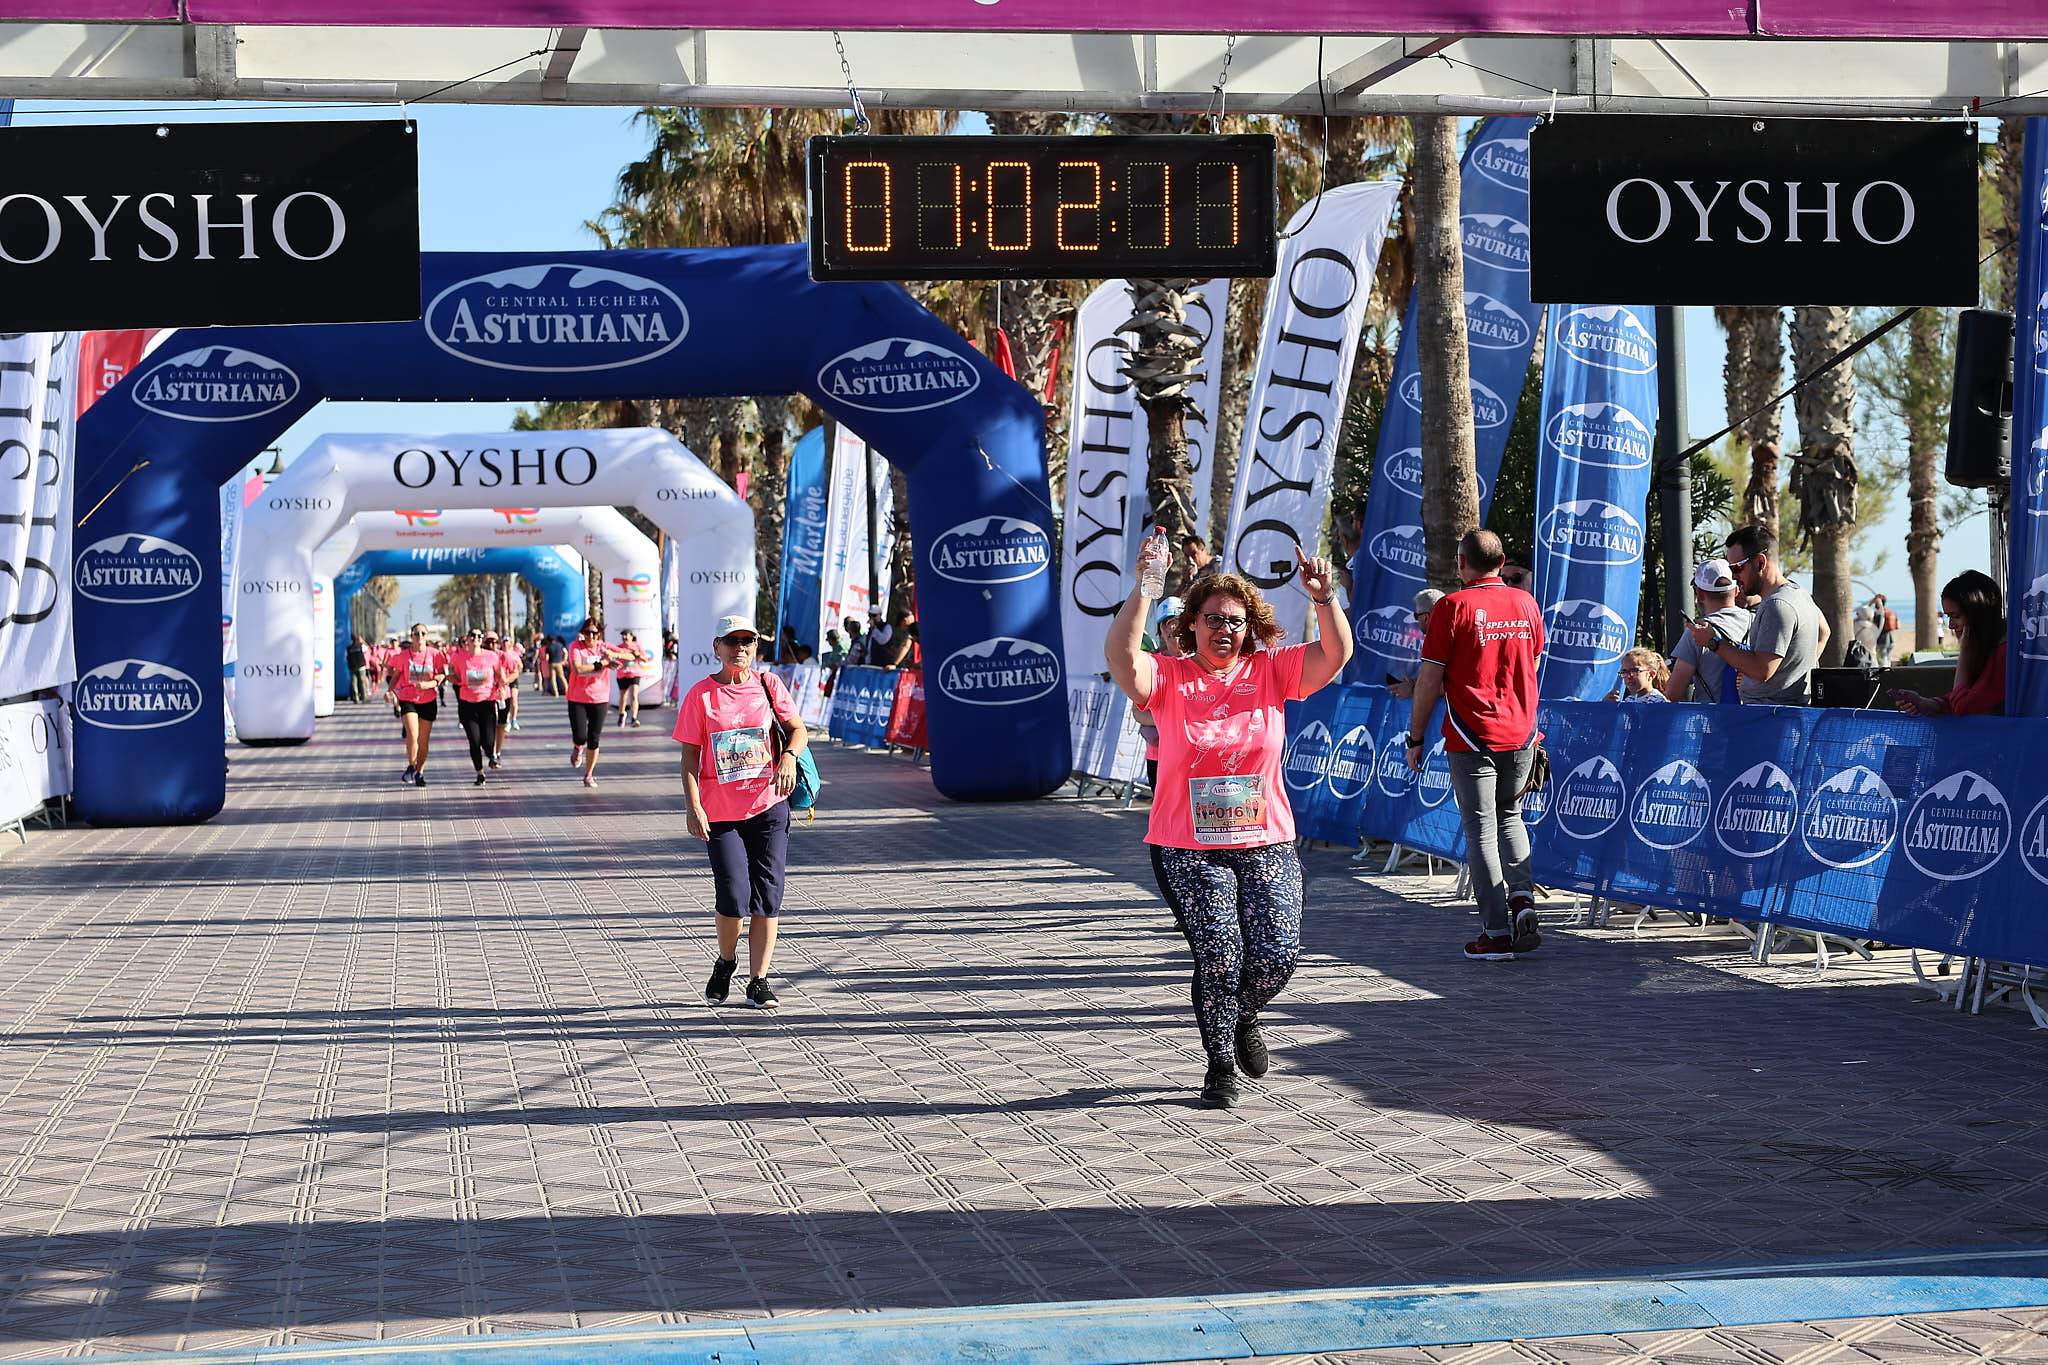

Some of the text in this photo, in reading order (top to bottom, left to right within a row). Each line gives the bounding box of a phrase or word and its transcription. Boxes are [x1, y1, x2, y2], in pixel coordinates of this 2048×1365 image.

[845, 160, 1239, 252] 01:02:11
[1606, 178, 1915, 245] OYSHO
[0, 191, 346, 264] OYSHO
[486, 295, 661, 307] CENTRAL LECHERA
[445, 298, 671, 343] ASTURIANA
[1467, 317, 1519, 343] RIANA
[170, 371, 284, 380] CENTRAL LECHERA
[851, 360, 962, 374] CENTRAL LECHERA
[142, 375, 287, 402] ASTURIANA
[832, 369, 971, 396] ASTURIANA
[1235, 247, 1357, 590] OYSHO
[1554, 418, 1648, 460] ASTURIANA
[393, 446, 598, 489] OYSHO
[1072, 337, 1134, 619] OYSHO
[269, 496, 331, 511] OYSHO
[657, 488, 717, 502] OYSHO
[792, 485, 826, 576] Marlene
[94, 557, 190, 565] CENTRAL LECHERA
[938, 544, 1047, 569] ASTURIANA
[79, 560, 194, 587] ASTURIANA
[690, 570, 746, 585] OYSHO
[243, 581, 301, 594] OYSHO
[1486, 620, 1529, 630] SPEAKER
[1486, 631, 1516, 641] TONY
[243, 664, 302, 679] OYSHO
[946, 665, 1056, 690] ASTURIANA
[79, 685, 194, 712] ASTURIANA
[94, 683, 190, 691] CENTRAL LECHERA
[1186, 694, 1216, 702] OYSHO
[1558, 785, 1617, 820] ASTURIANA
[1633, 790, 1701, 828] ASTURIANA
[1737, 794, 1792, 806] CENTRAL LECHERA
[1719, 796, 1790, 835] ASTURIANA
[1806, 800, 1889, 844] ASTURIANA
[1931, 807, 2002, 821] CENTRAL LECHERA
[1908, 808, 2000, 854] ASTURIANA
